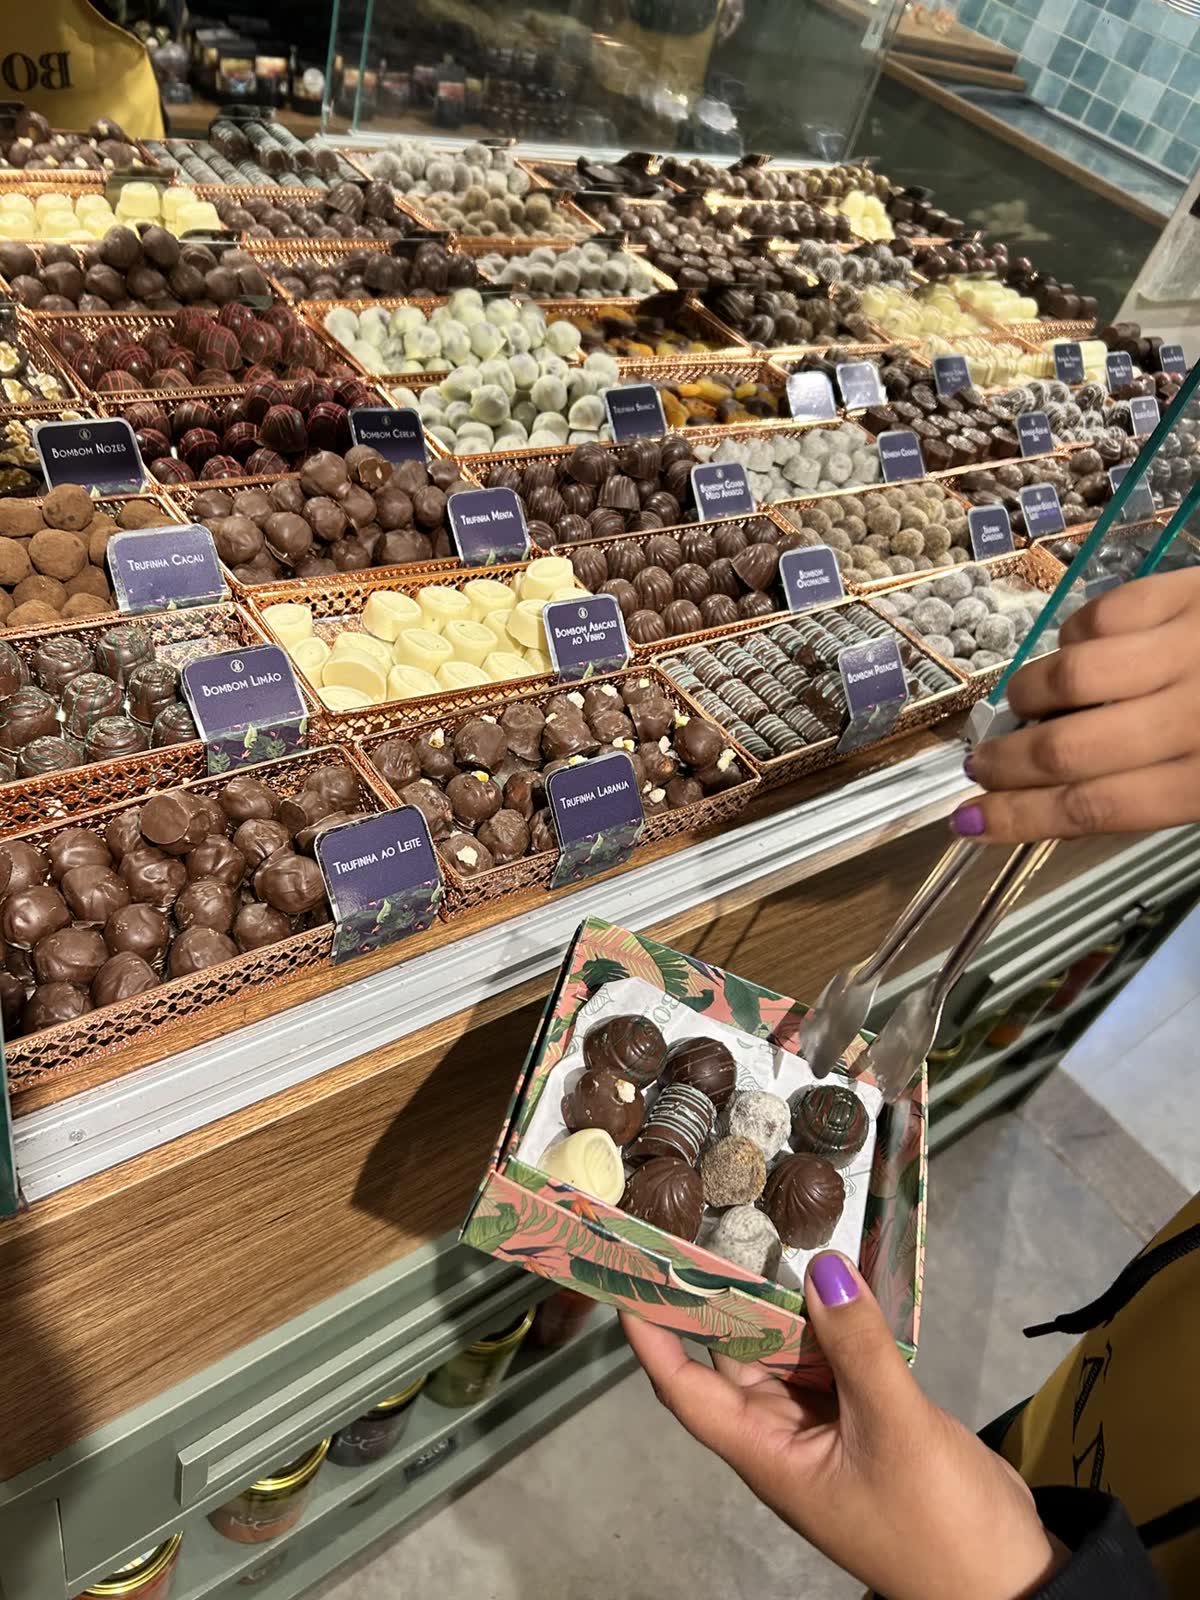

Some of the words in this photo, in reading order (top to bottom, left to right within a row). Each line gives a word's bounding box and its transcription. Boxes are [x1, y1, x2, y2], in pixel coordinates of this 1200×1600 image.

[360, 430, 391, 440] BOMBOM
[393, 428, 416, 439] CEREJA
[51, 445, 93, 459] BOMBOM
[96, 443, 126, 454] NOZES
[460, 515, 491, 526] TRUFINHA
[491, 511, 514, 522] MENTA
[127, 559, 169, 571] TRUFINHA
[171, 553, 204, 565] CACAU
[798, 569, 824, 580] BOMBOM
[555, 625, 587, 638] BOMBOM
[589, 620, 617, 632] ABACAXI
[572, 637, 582, 646] AO
[584, 631, 606, 643] VINHO
[847, 668, 874, 684] BOMBOM
[874, 660, 899, 676] PISTACHE
[202, 681, 248, 697] BOMBOM
[250, 671, 282, 686] LIMÃO
[560, 792, 596, 809] TRUFINHA
[597, 780, 630, 798] LARANJA
[333, 854, 378, 875] TRUFINHA
[381, 846, 395, 858] AO
[397, 837, 422, 853] LEITE
